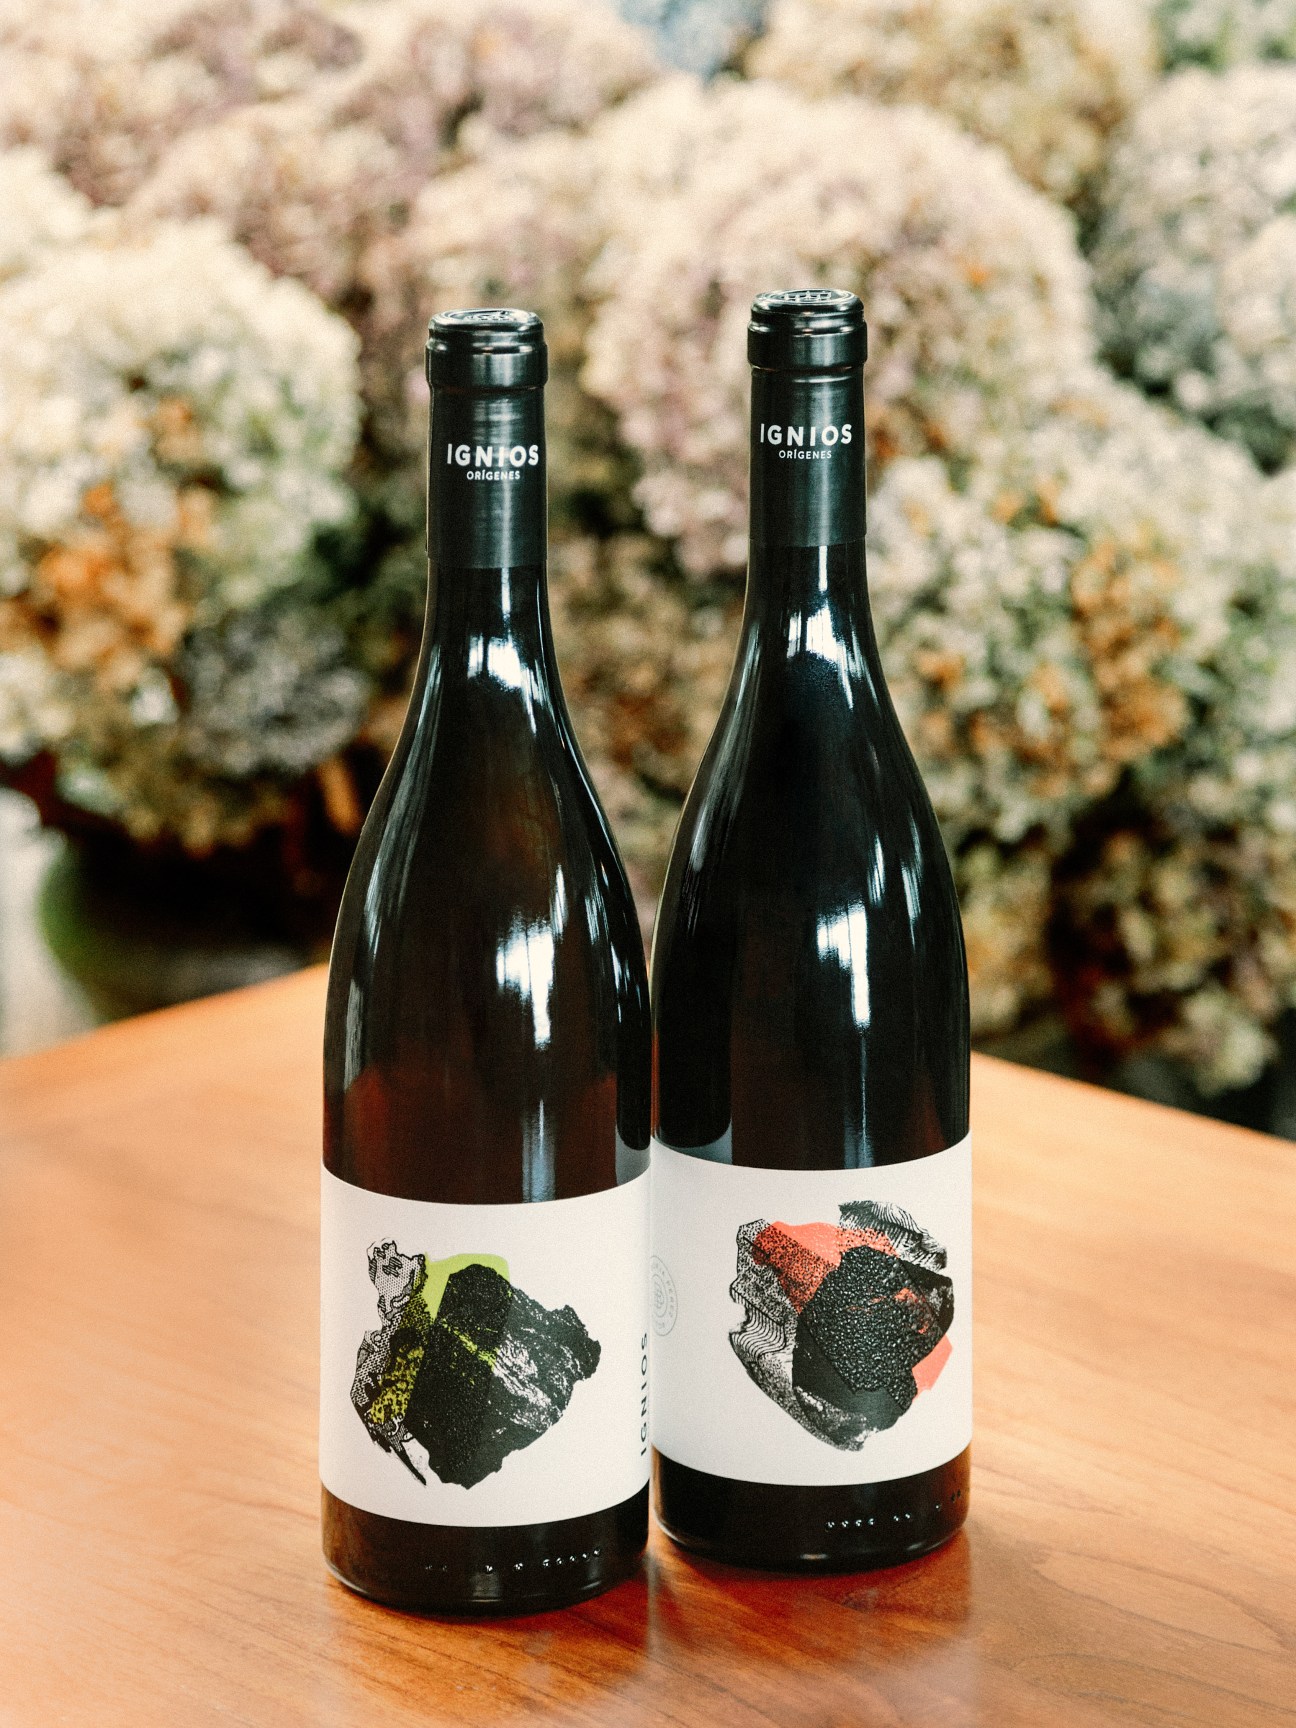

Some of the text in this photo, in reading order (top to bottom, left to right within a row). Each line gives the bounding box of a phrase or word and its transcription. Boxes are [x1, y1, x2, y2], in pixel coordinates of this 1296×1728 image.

[760, 423, 852, 447] IGNIOS
[446, 443, 539, 468] IGNIOS
[640, 1332, 648, 1456] IGNIOS
